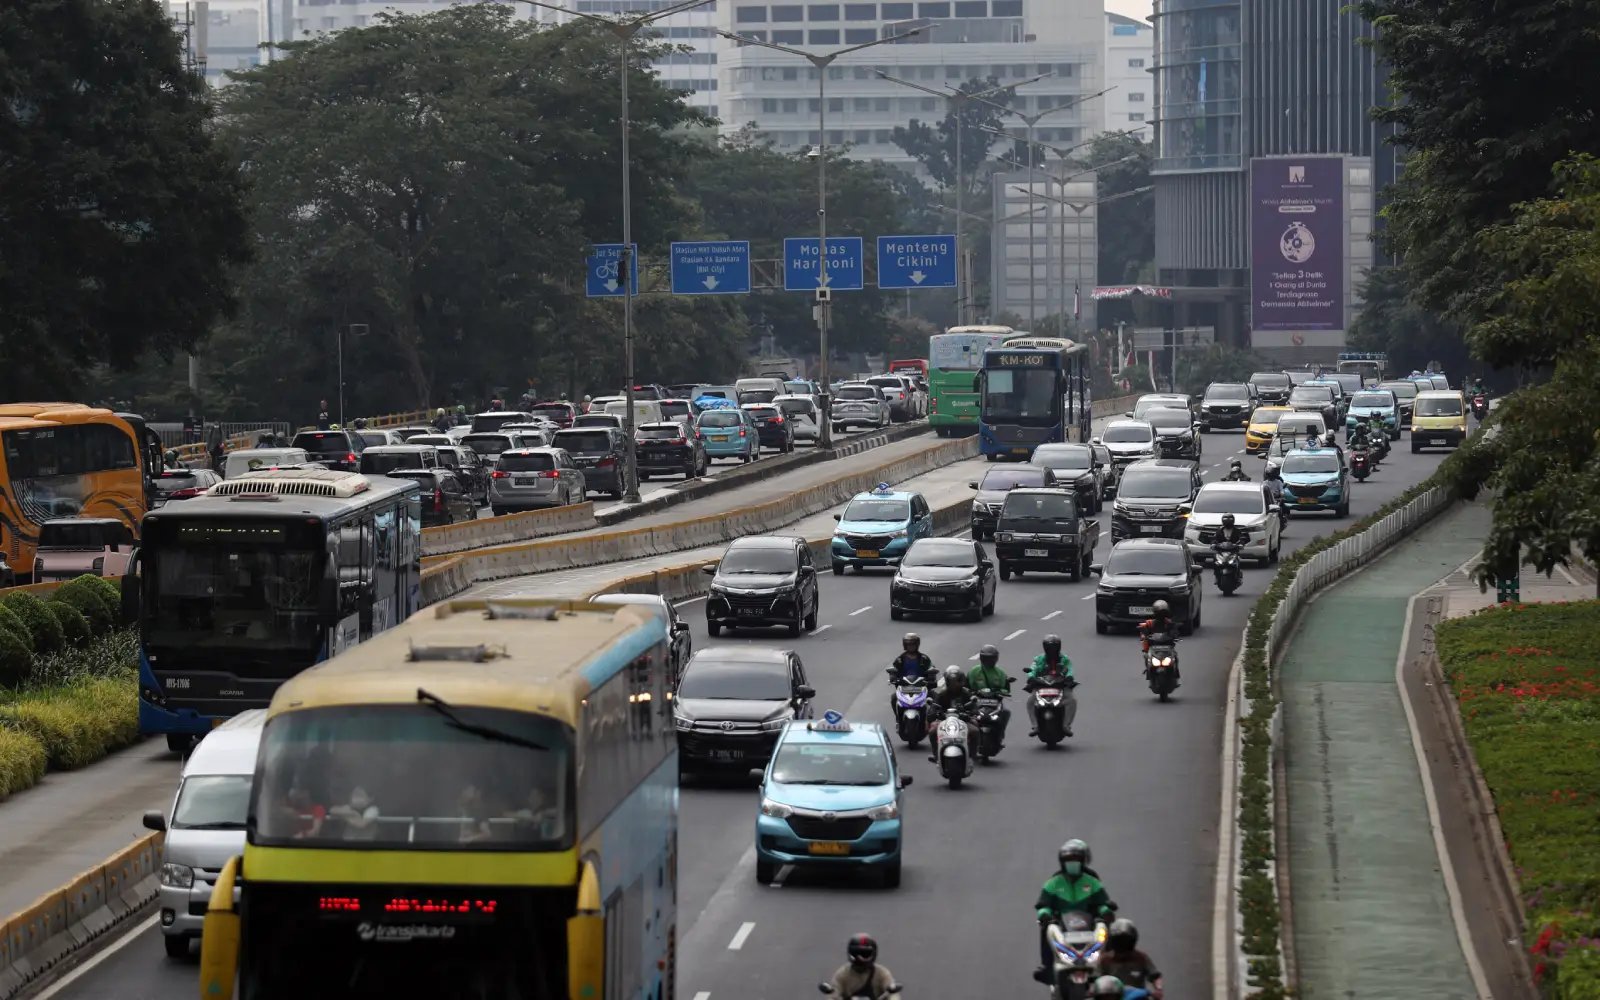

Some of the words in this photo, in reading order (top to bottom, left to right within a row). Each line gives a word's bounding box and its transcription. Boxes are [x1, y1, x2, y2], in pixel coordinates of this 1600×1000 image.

[886, 242, 947, 254] Menteng
[897, 255, 937, 267] Cikini
[1298, 270, 1304, 278] 3
[1274, 282, 1297, 290] Orang
[376, 923, 456, 940] transjakarta
